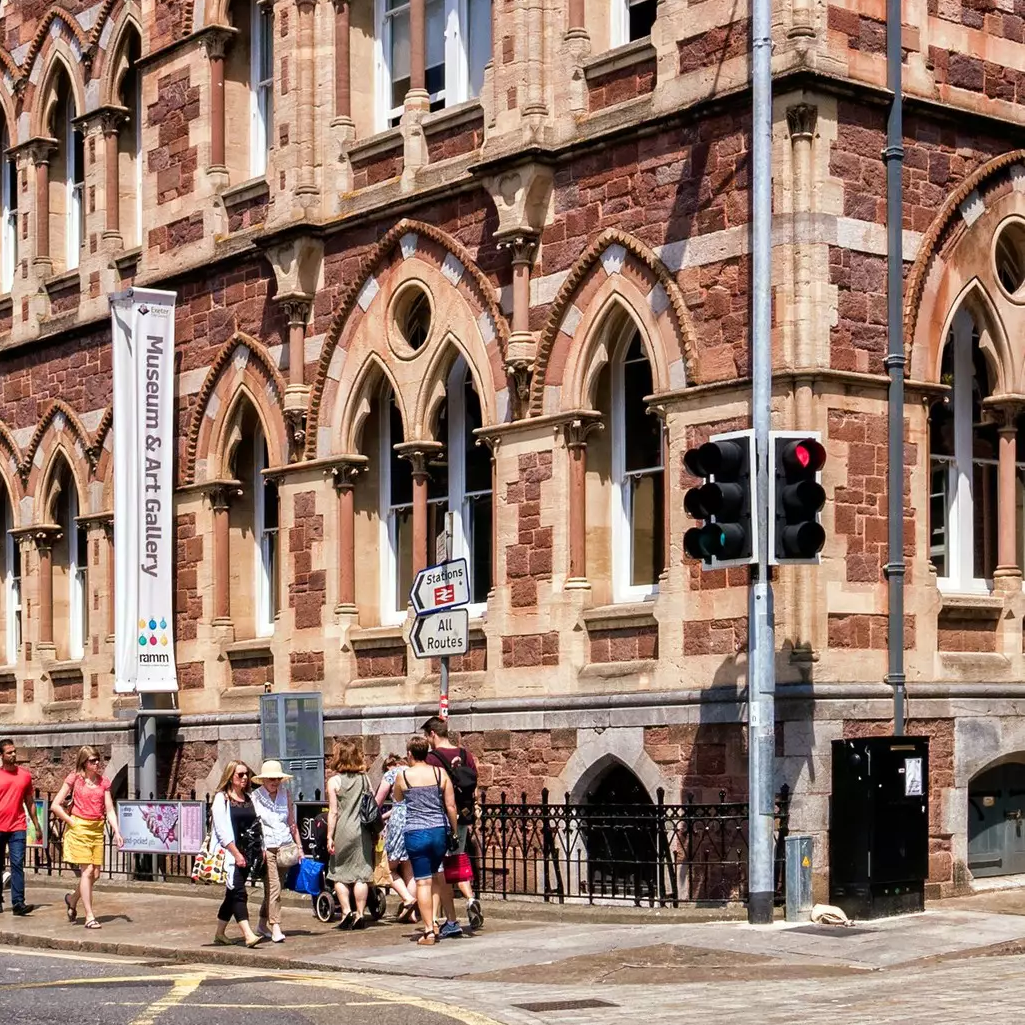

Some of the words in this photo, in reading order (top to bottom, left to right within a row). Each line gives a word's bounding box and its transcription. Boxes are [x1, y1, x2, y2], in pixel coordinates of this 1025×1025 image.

[146, 335, 164, 429] Museum
[145, 434, 162, 451] &
[144, 457, 161, 492] Art
[140, 496, 162, 578] Gallery
[426, 568, 463, 585] Stations
[438, 618, 452, 632] All
[427, 636, 463, 650] Routes
[139, 654, 169, 663] ramm
